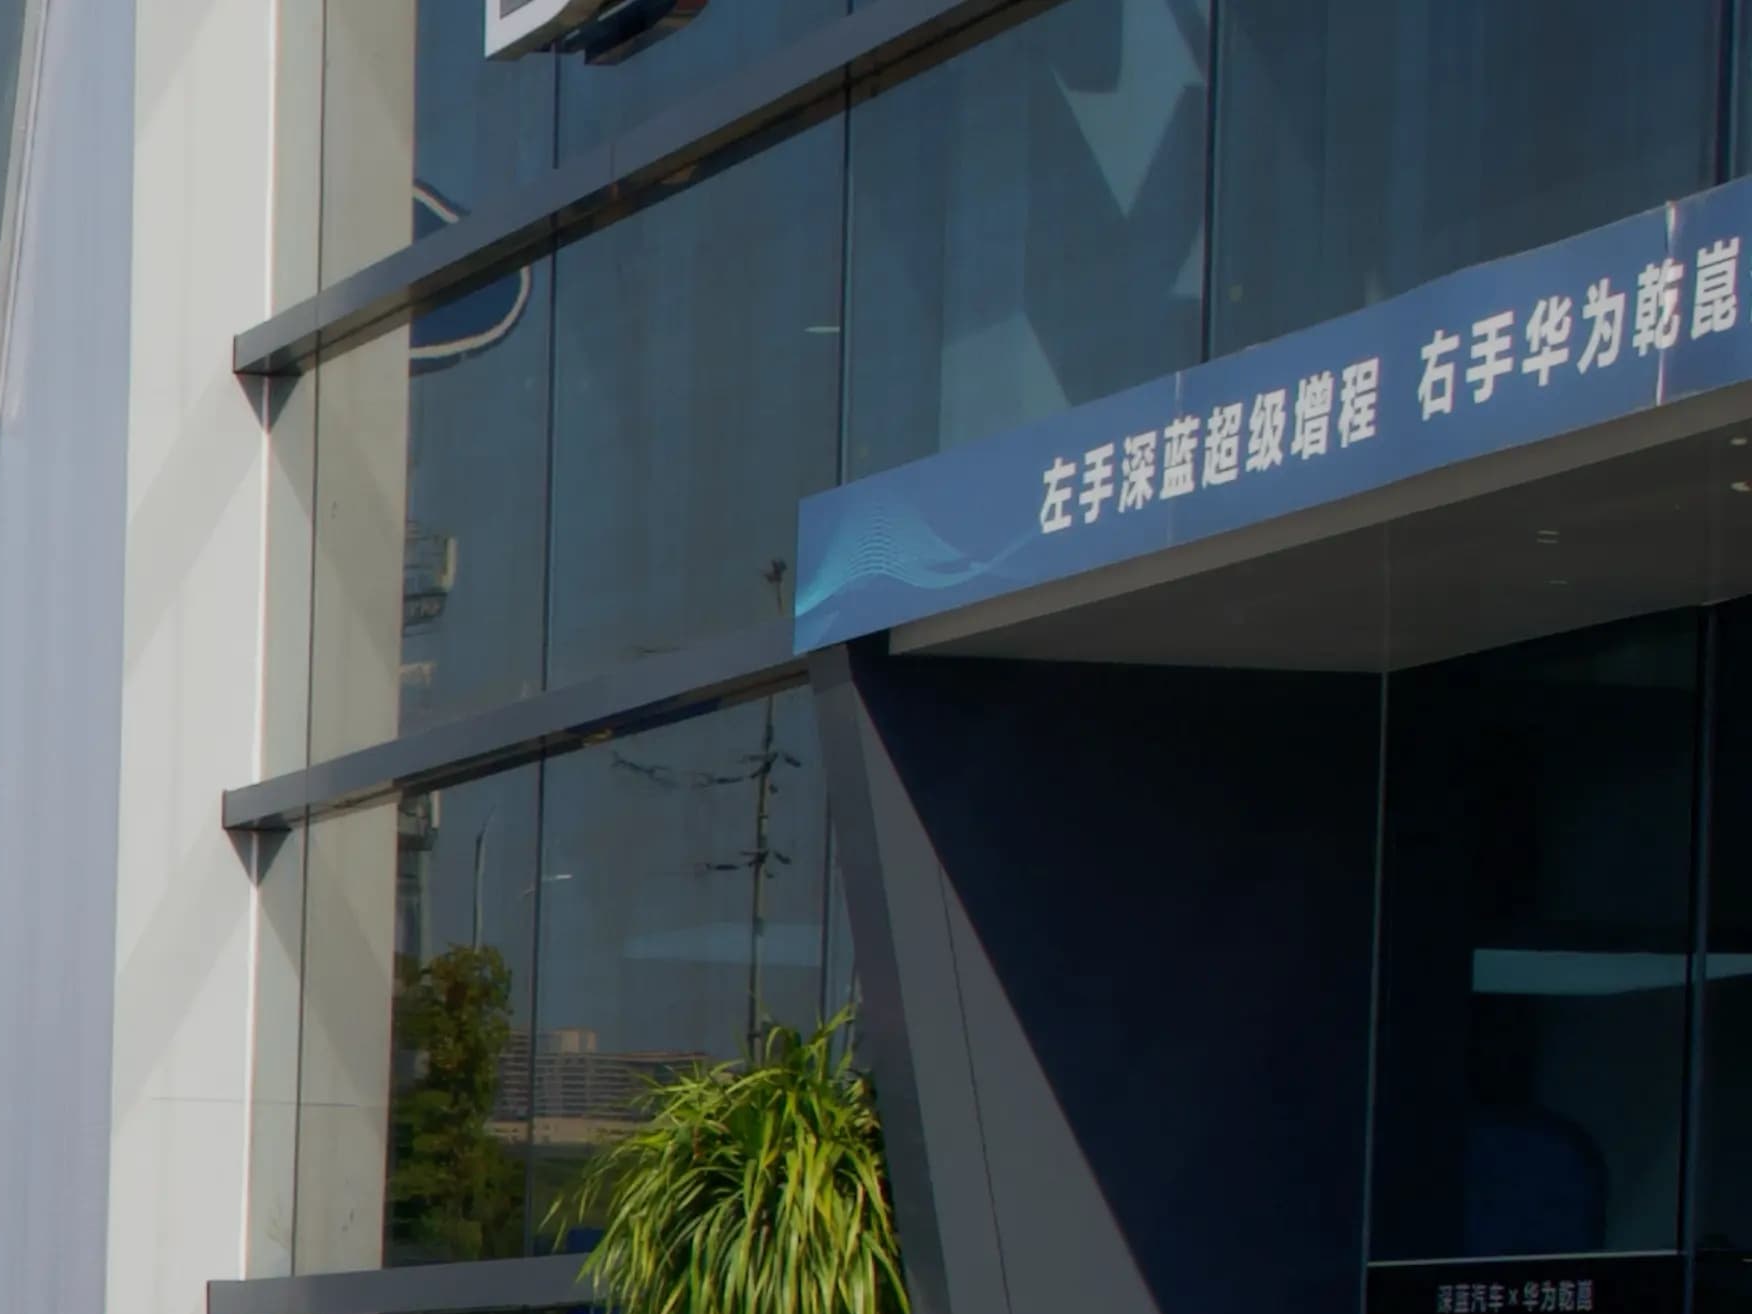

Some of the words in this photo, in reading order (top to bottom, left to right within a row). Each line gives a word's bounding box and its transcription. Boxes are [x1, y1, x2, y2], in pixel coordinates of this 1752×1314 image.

[1039, 356, 1381, 534] 左手深蓝超级增程
